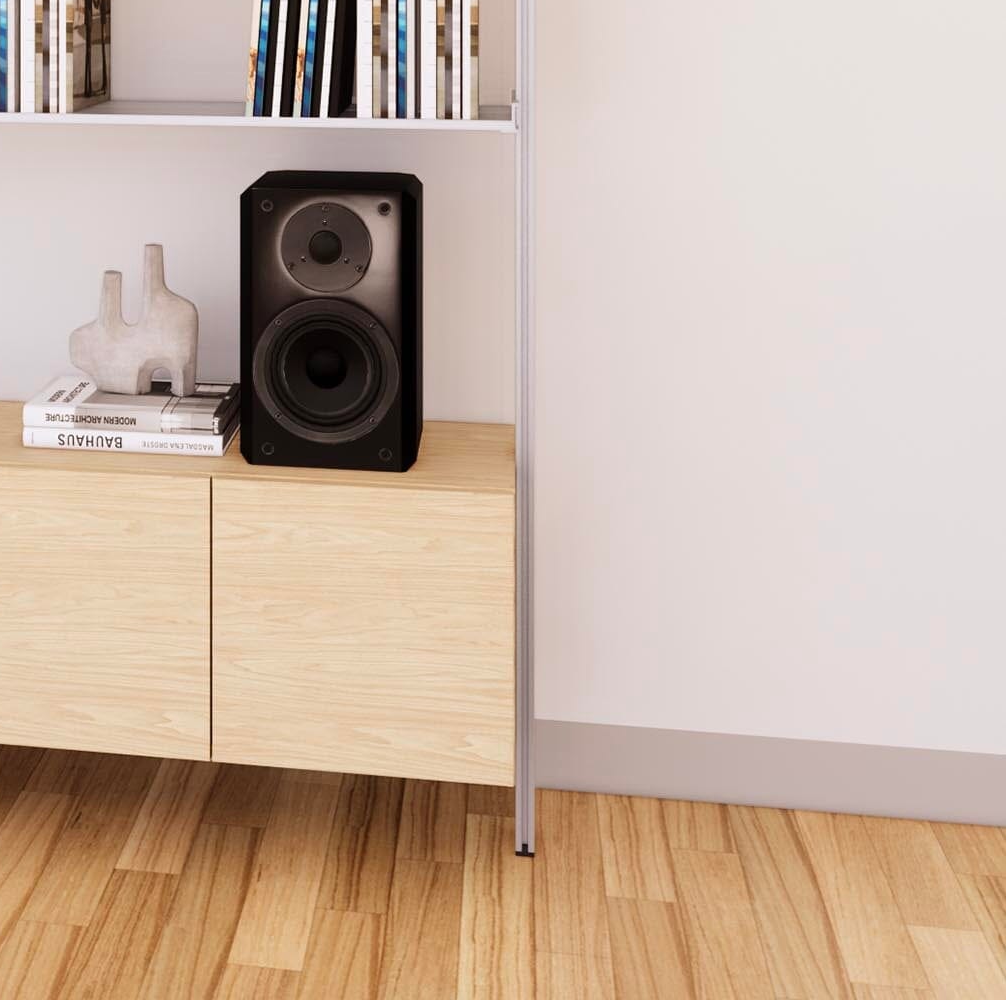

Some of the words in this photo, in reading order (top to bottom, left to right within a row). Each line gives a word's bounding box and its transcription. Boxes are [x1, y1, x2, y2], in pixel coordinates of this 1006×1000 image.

[45, 413, 102, 424] ARCHITECTURE
[104, 416, 137, 426] MODERN
[57, 433, 123, 449] BAUHAUS
[169, 442, 214, 451] MAGDALENA
